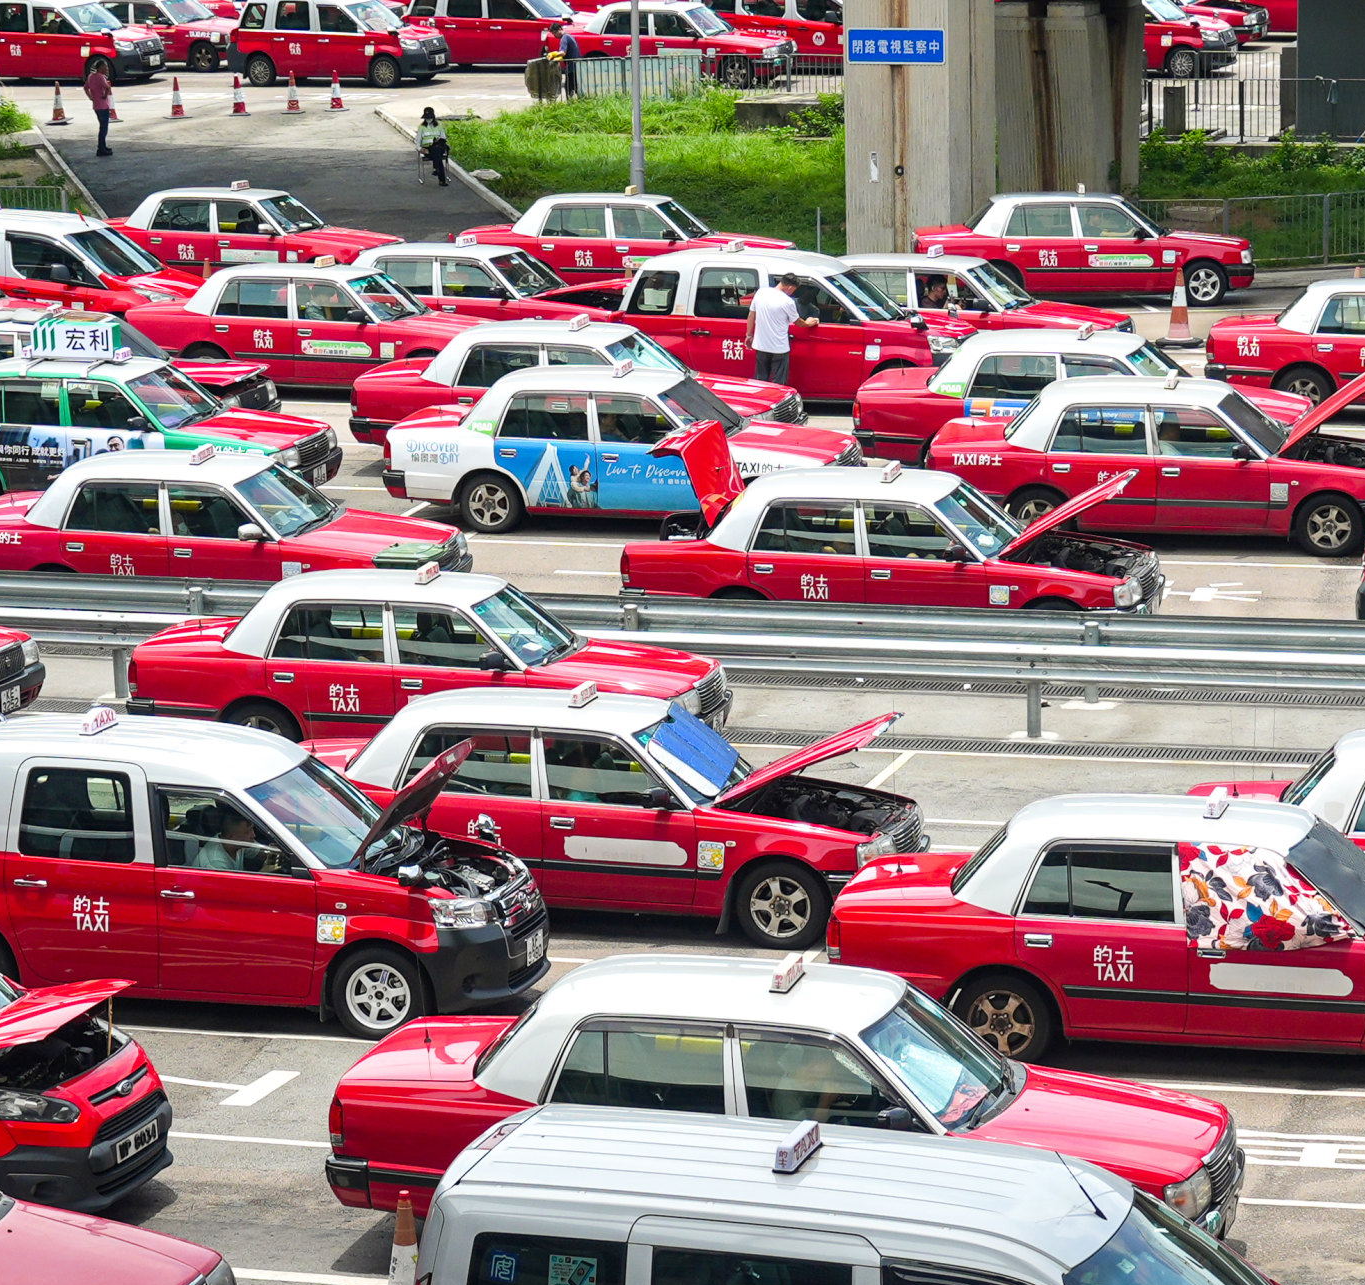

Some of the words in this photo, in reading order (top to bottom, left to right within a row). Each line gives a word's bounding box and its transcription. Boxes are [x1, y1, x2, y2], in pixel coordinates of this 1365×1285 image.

[852, 39, 939, 54] 閉路電視監察中
[178, 244, 194, 252] 的士
[1039, 249, 1057, 258] 的士
[178, 252, 195, 260] TAXI
[575, 250, 592, 259] 的士
[575, 258, 593, 267] TAXI
[1039, 258, 1057, 267] TAXI
[65, 328, 109, 351] 宏利
[253, 330, 271, 339] 的士
[254, 339, 273, 349] TAXI
[722, 339, 743, 350] 的士
[722, 349, 743, 360] TAXI
[940, 384, 961, 392] POAD
[406, 440, 459, 453] DISCOVERY
[411, 453, 439, 464] 愉景灣
[439, 452, 459, 464] BAY
[952, 453, 977, 465] TAXI
[978, 454, 1003, 466] 的士
[606, 463, 628, 475] Live
[737, 462, 760, 473] TAXI
[0, 531, 22, 545] 的士
[110, 553, 133, 566] 的士
[110, 565, 135, 577] TAXI
[801, 573, 828, 587] 的士
[801, 587, 828, 599] TAXI
[329, 684, 359, 698] 的士
[2, 698, 20, 713] 3252
[329, 697, 359, 712] TAXI
[94, 710, 116, 727] TAXI
[73, 895, 110, 914] 的士
[72, 913, 109, 932] TAXI
[1093, 945, 1133, 964] 的士
[1093, 963, 1134, 982] TAXI
[793, 1126, 820, 1161] TAXI
